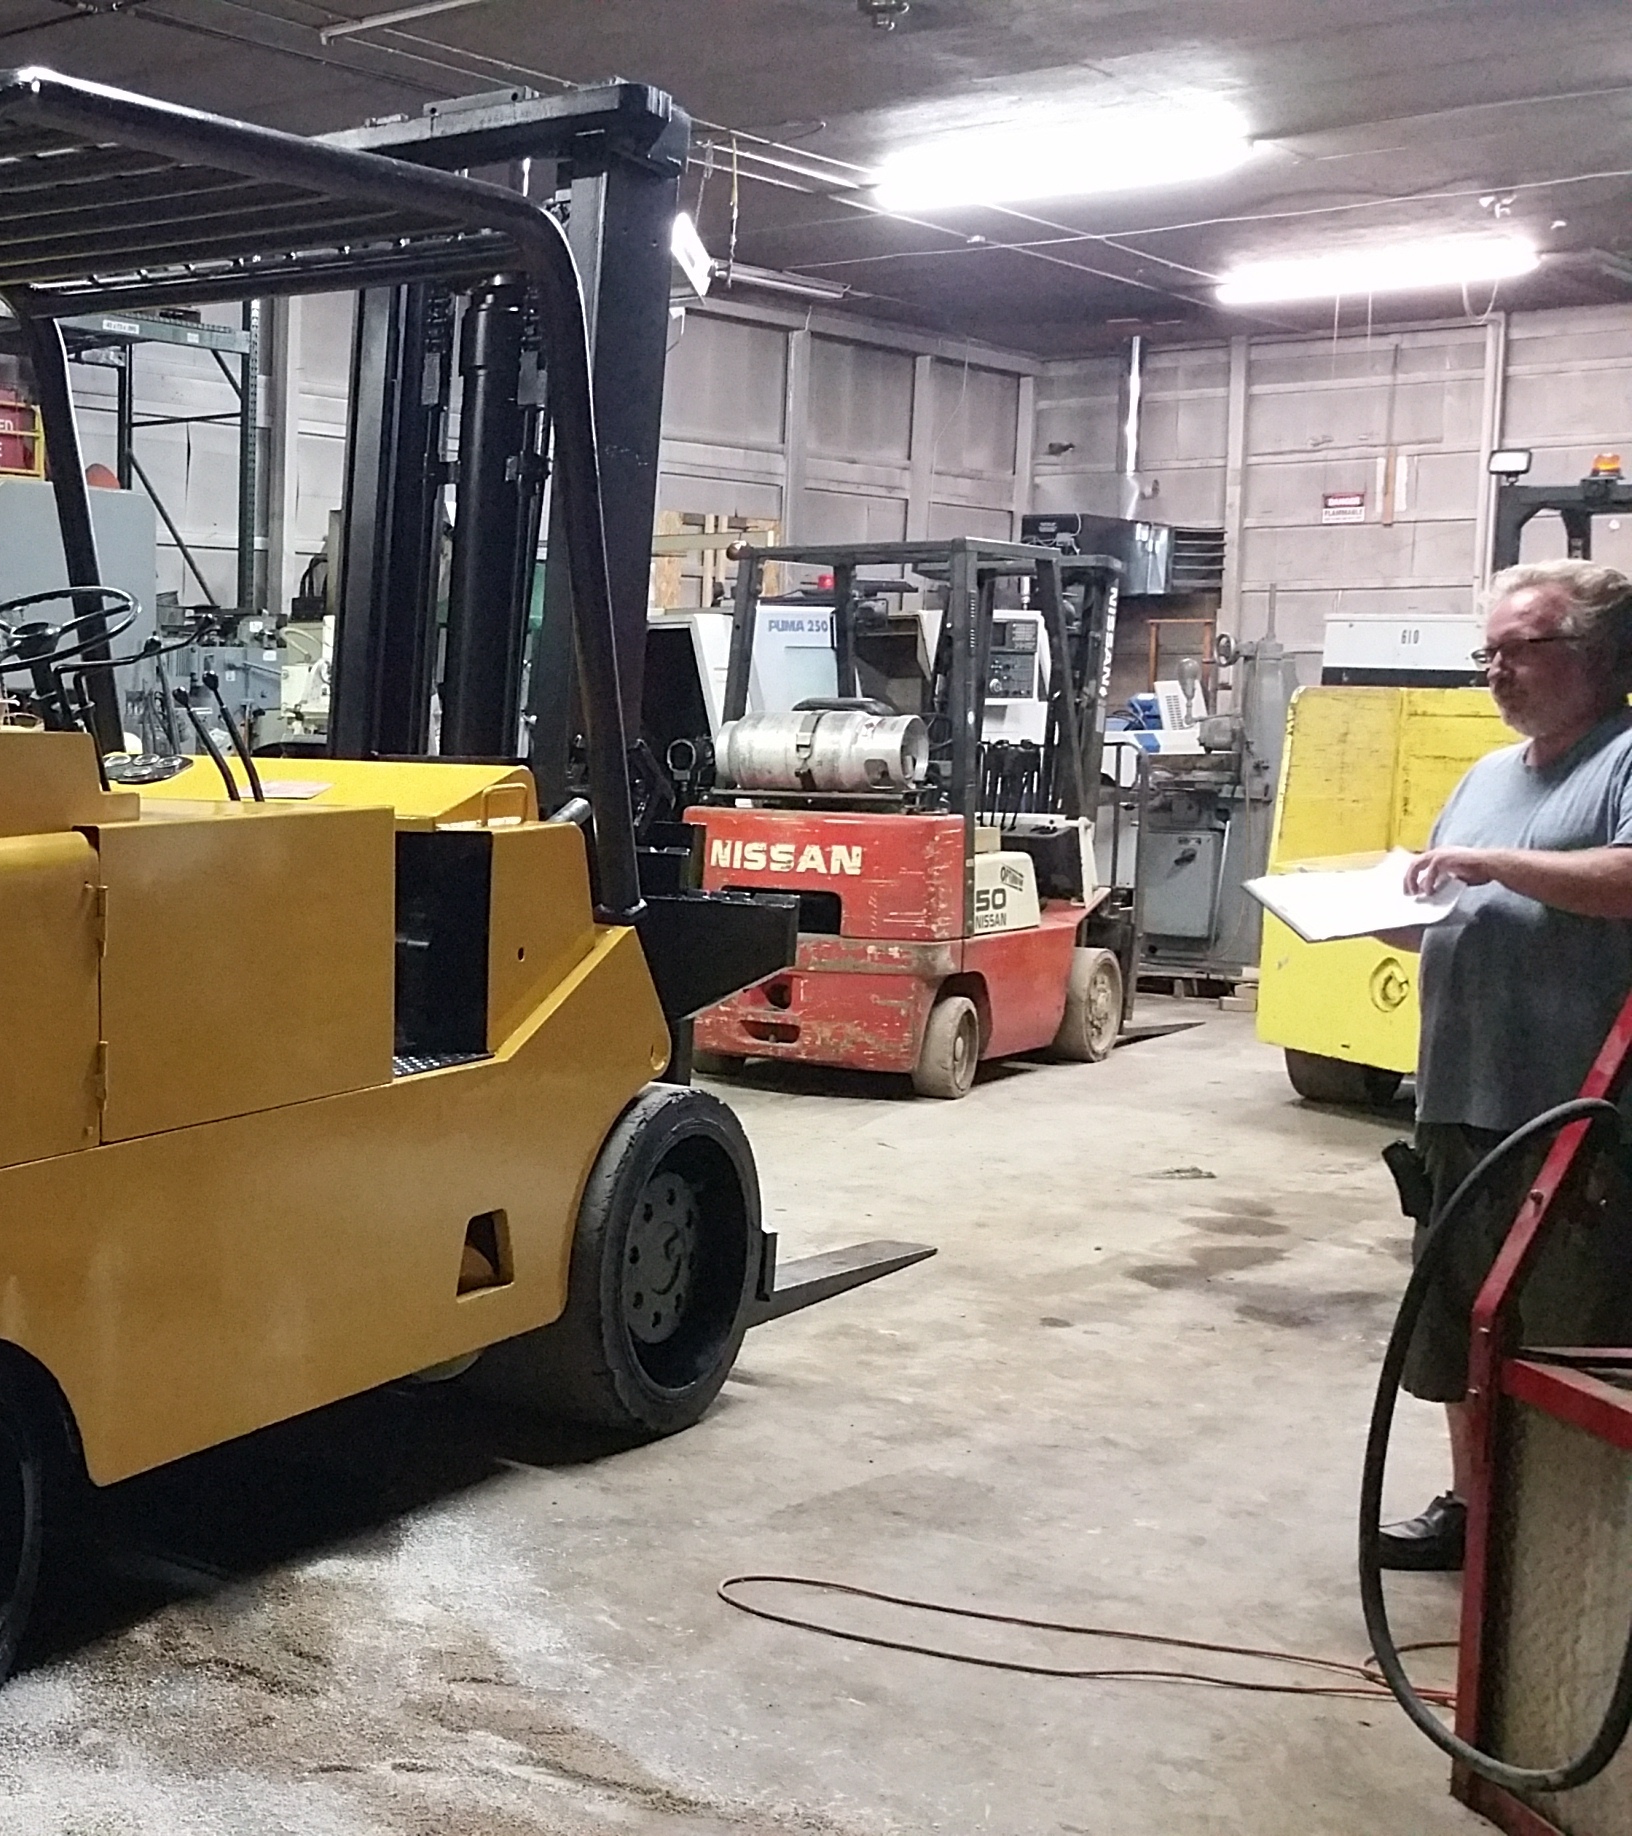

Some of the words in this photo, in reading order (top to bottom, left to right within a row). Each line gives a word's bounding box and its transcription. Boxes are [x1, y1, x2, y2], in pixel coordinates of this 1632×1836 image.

[768, 620, 804, 632] PUMA
[807, 620, 828, 632] 250
[1101, 587, 1117, 686] NISSAN
[1401, 629, 1420, 644] 610
[710, 839, 863, 875] NISSAN
[975, 913, 1006, 929] NISSAN
